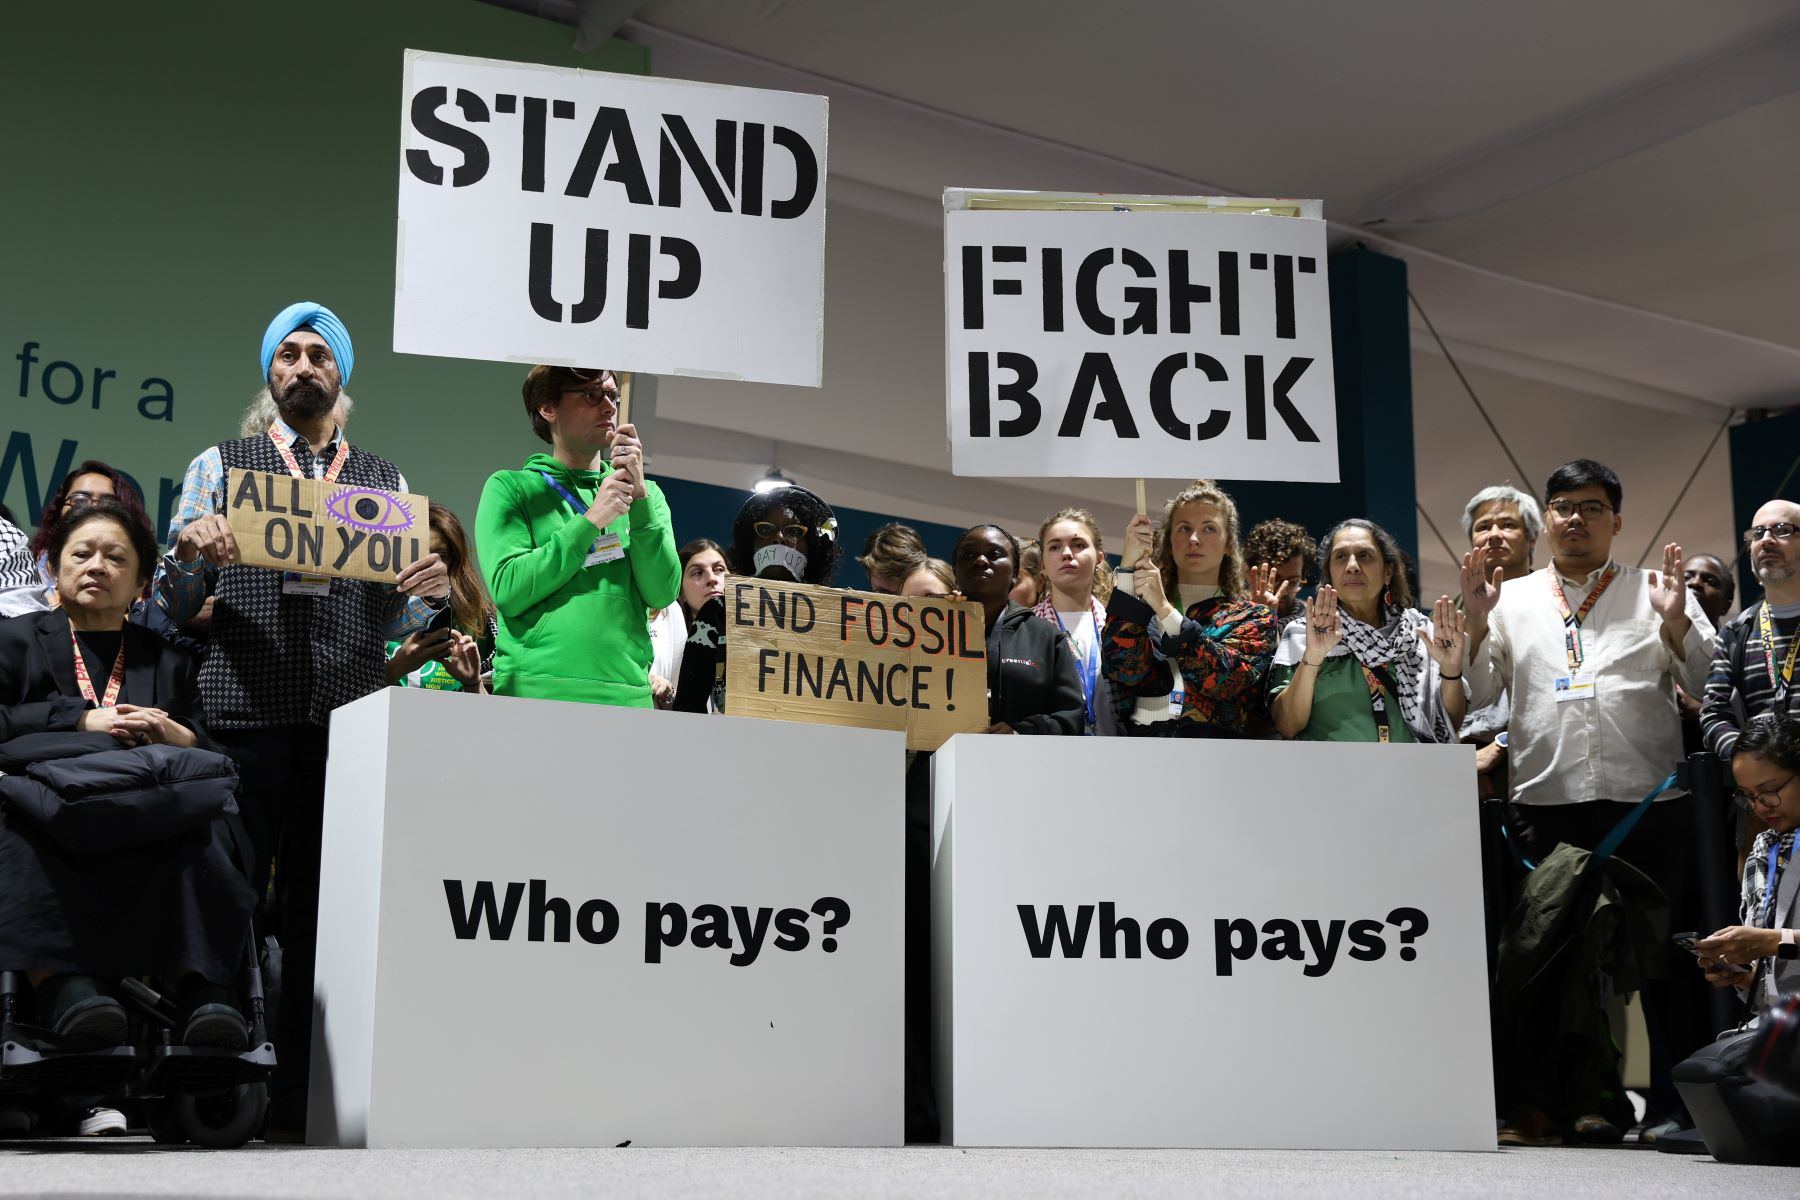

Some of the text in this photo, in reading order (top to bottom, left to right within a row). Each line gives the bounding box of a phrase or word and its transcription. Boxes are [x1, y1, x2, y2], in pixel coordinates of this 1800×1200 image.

[405, 86, 819, 220] STAND
[528, 222, 702, 330] UP
[962, 245, 1317, 340] FIGHT
[16, 341, 174, 423] for a
[968, 351, 1321, 443] BACK
[232, 471, 313, 519] ALL
[327, 442, 348, 477] TRILLION
[265, 517, 419, 574] ON YOU
[757, 548, 777, 566] PAY
[735, 584, 985, 660] END FOSSIL
[1761, 628, 1772, 651] PAY
[758, 649, 956, 711] FINANCE!
[443, 879, 851, 967] Who pays?
[1017, 901, 1429, 978] Who pays?
